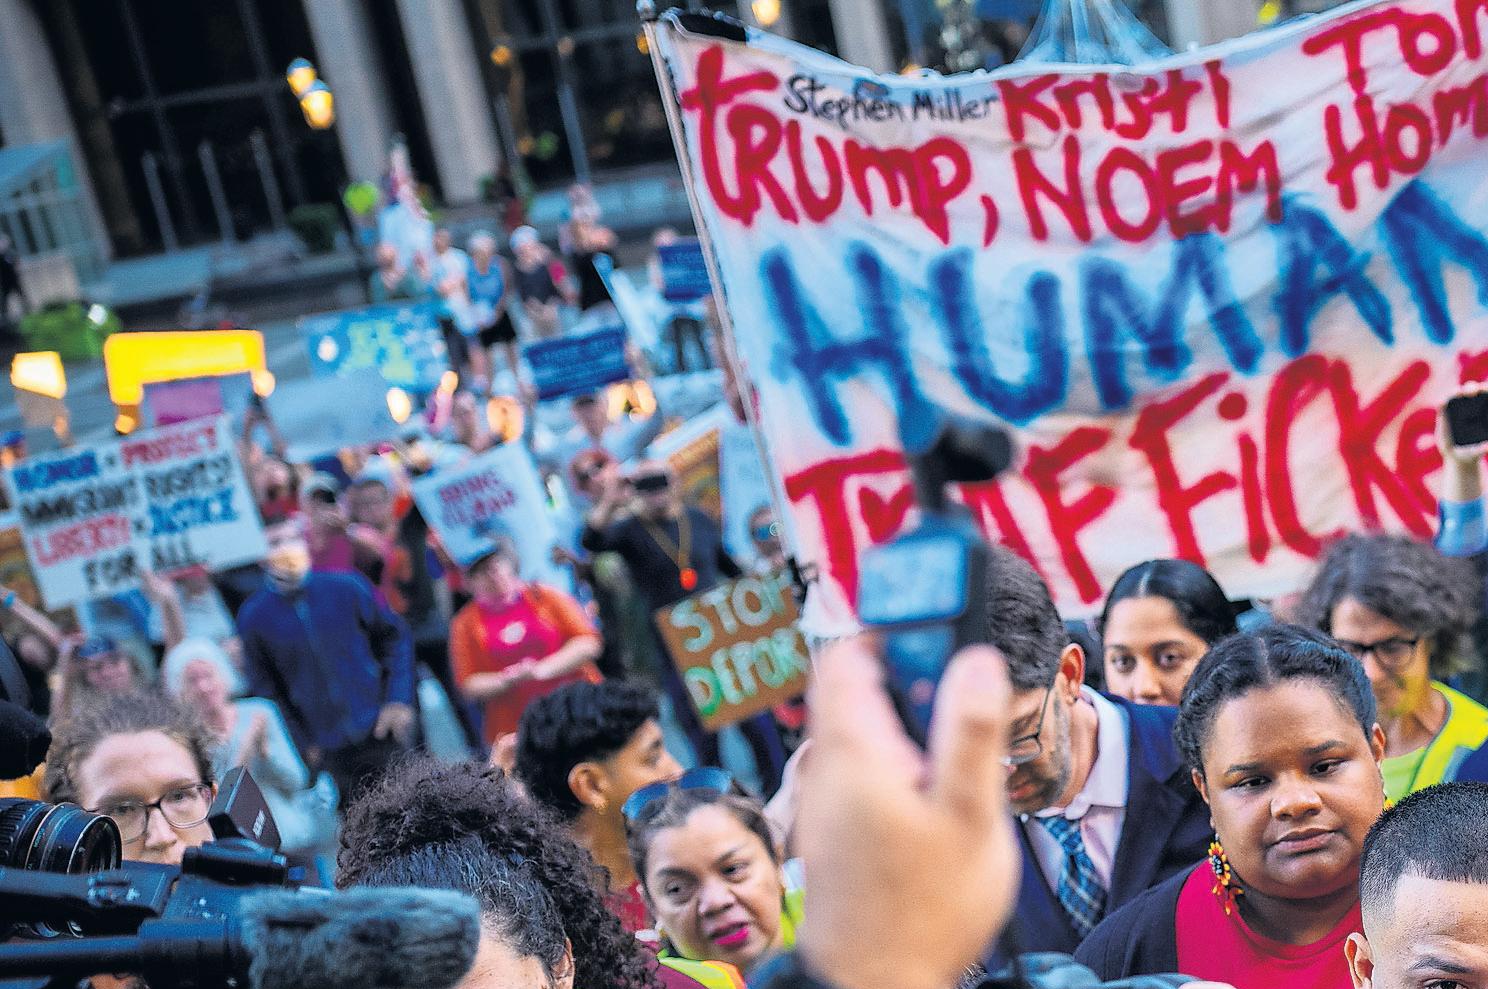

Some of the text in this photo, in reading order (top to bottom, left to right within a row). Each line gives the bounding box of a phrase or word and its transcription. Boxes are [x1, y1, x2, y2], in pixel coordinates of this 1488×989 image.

[784, 75, 998, 130] Stephen Miller
[1012, 135, 1283, 243] NOEM
